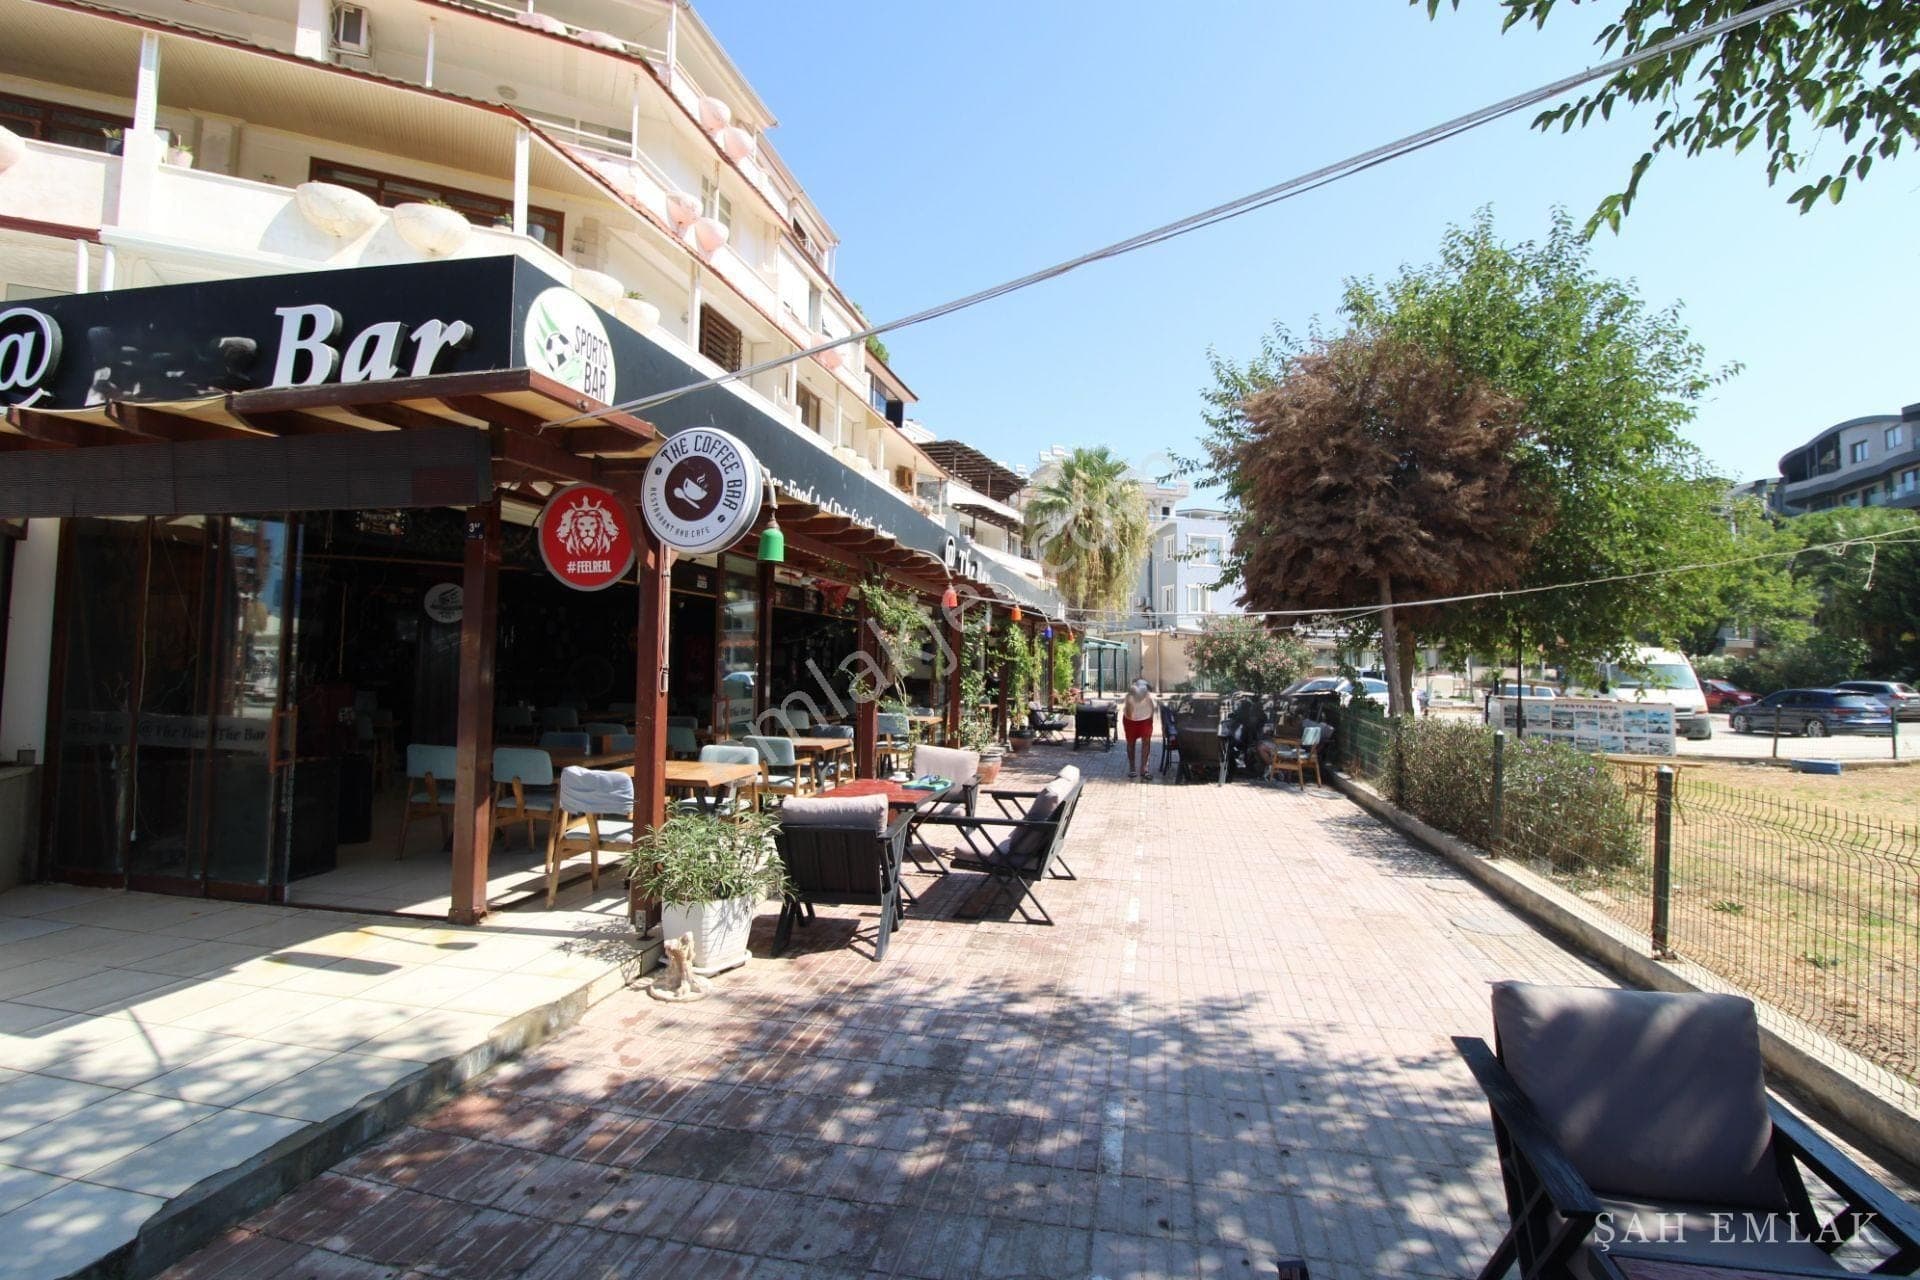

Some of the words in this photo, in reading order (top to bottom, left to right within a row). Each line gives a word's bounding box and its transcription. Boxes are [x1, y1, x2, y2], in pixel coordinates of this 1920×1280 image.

[272, 304, 467, 389] Bar
[575, 325, 608, 369] SPORTS
[584, 361, 607, 402] BAR
[660, 438, 689, 463] THE
[694, 434, 740, 475] COFFEE
[722, 479, 743, 511] BAR
[650, 487, 675, 533] RESTAURANT
[675, 528, 689, 538] AND
[691, 526, 711, 539] CAFE
[566, 560, 613, 573] #FEELREAL
